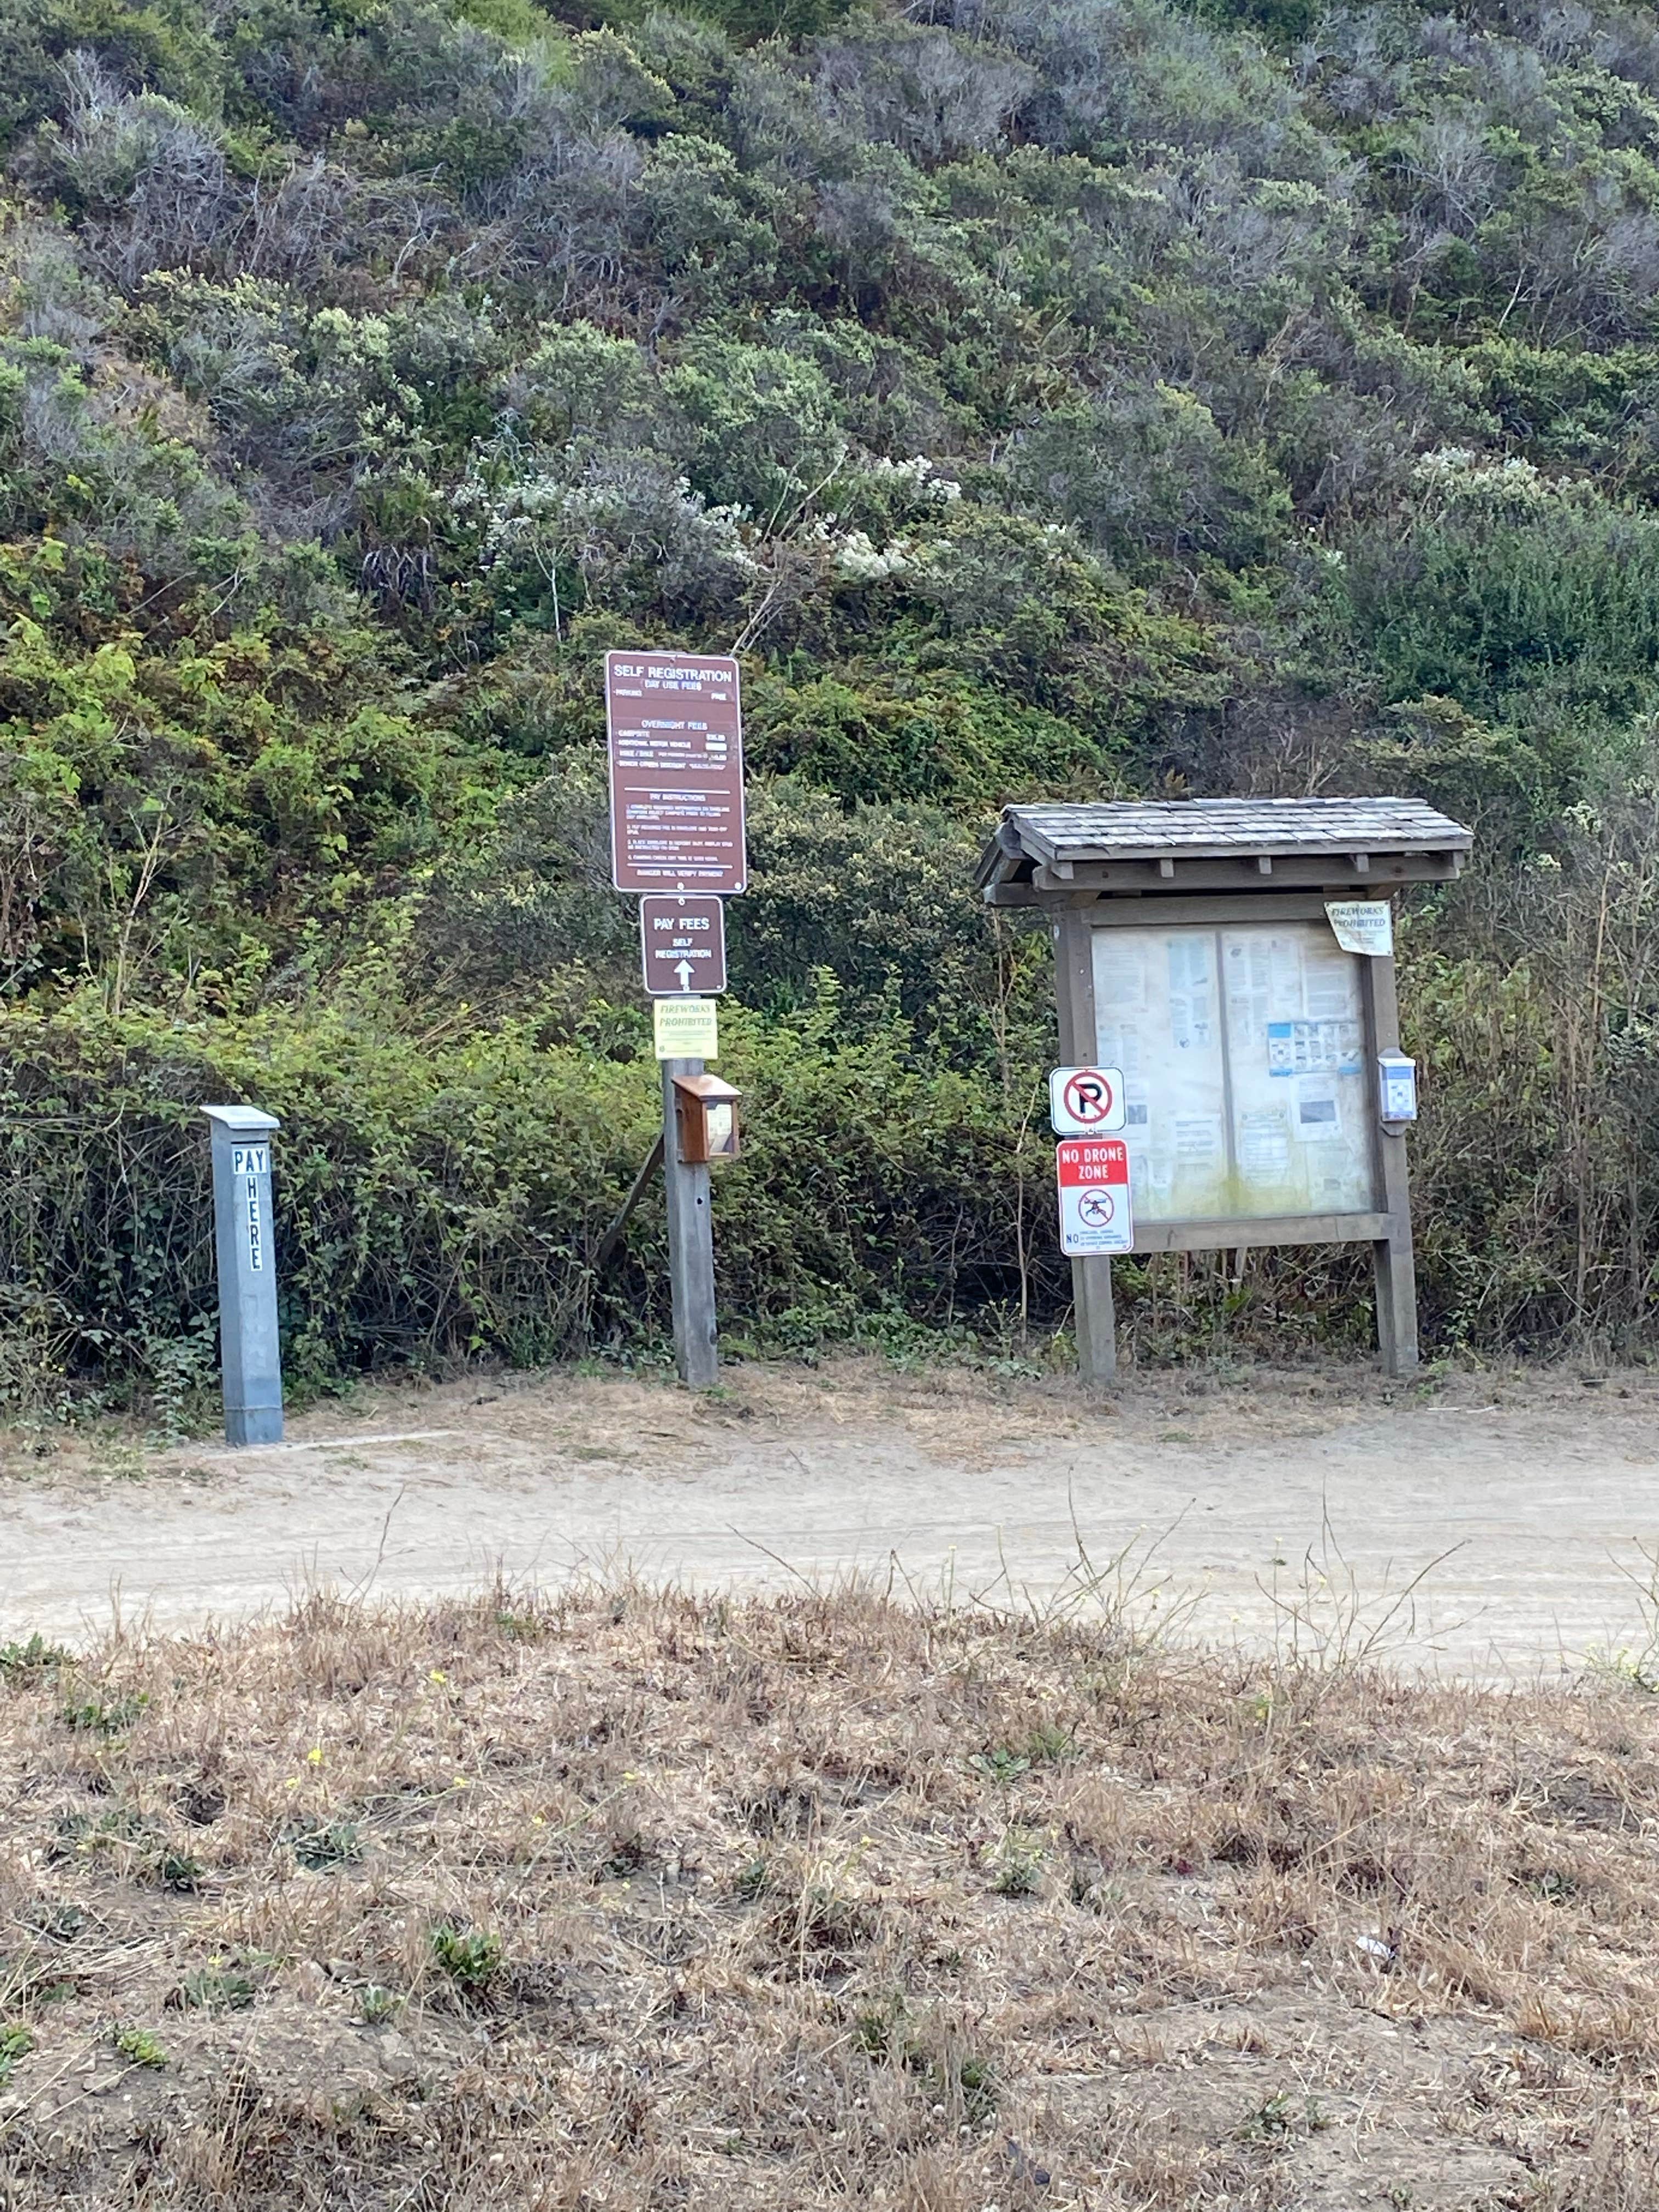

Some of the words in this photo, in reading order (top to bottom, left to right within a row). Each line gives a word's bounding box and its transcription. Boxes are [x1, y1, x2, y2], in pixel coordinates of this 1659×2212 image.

[614, 664, 644, 677] SELF
[648, 666, 732, 682] REGISTRATION
[641, 720, 685, 730] OVERNIGHT
[687, 721, 708, 730] FEES
[654, 918, 674, 930] PAY
[679, 917, 710, 930] FEES
[673, 938, 693, 947] SELF
[655, 949, 712, 959] REGISTRATION
[660, 1005, 711, 1014] FIREWORKS
[659, 1017, 712, 1027] PROHIBITED
[234, 1150, 264, 1172] PAY
[1062, 1149, 1079, 1164] NO
[1084, 1146, 1124, 1163] DRONE
[1078, 1164, 1109, 1180] ZONE
[247, 1177, 261, 1269] HERE
[1066, 1233, 1079, 1244] NO
